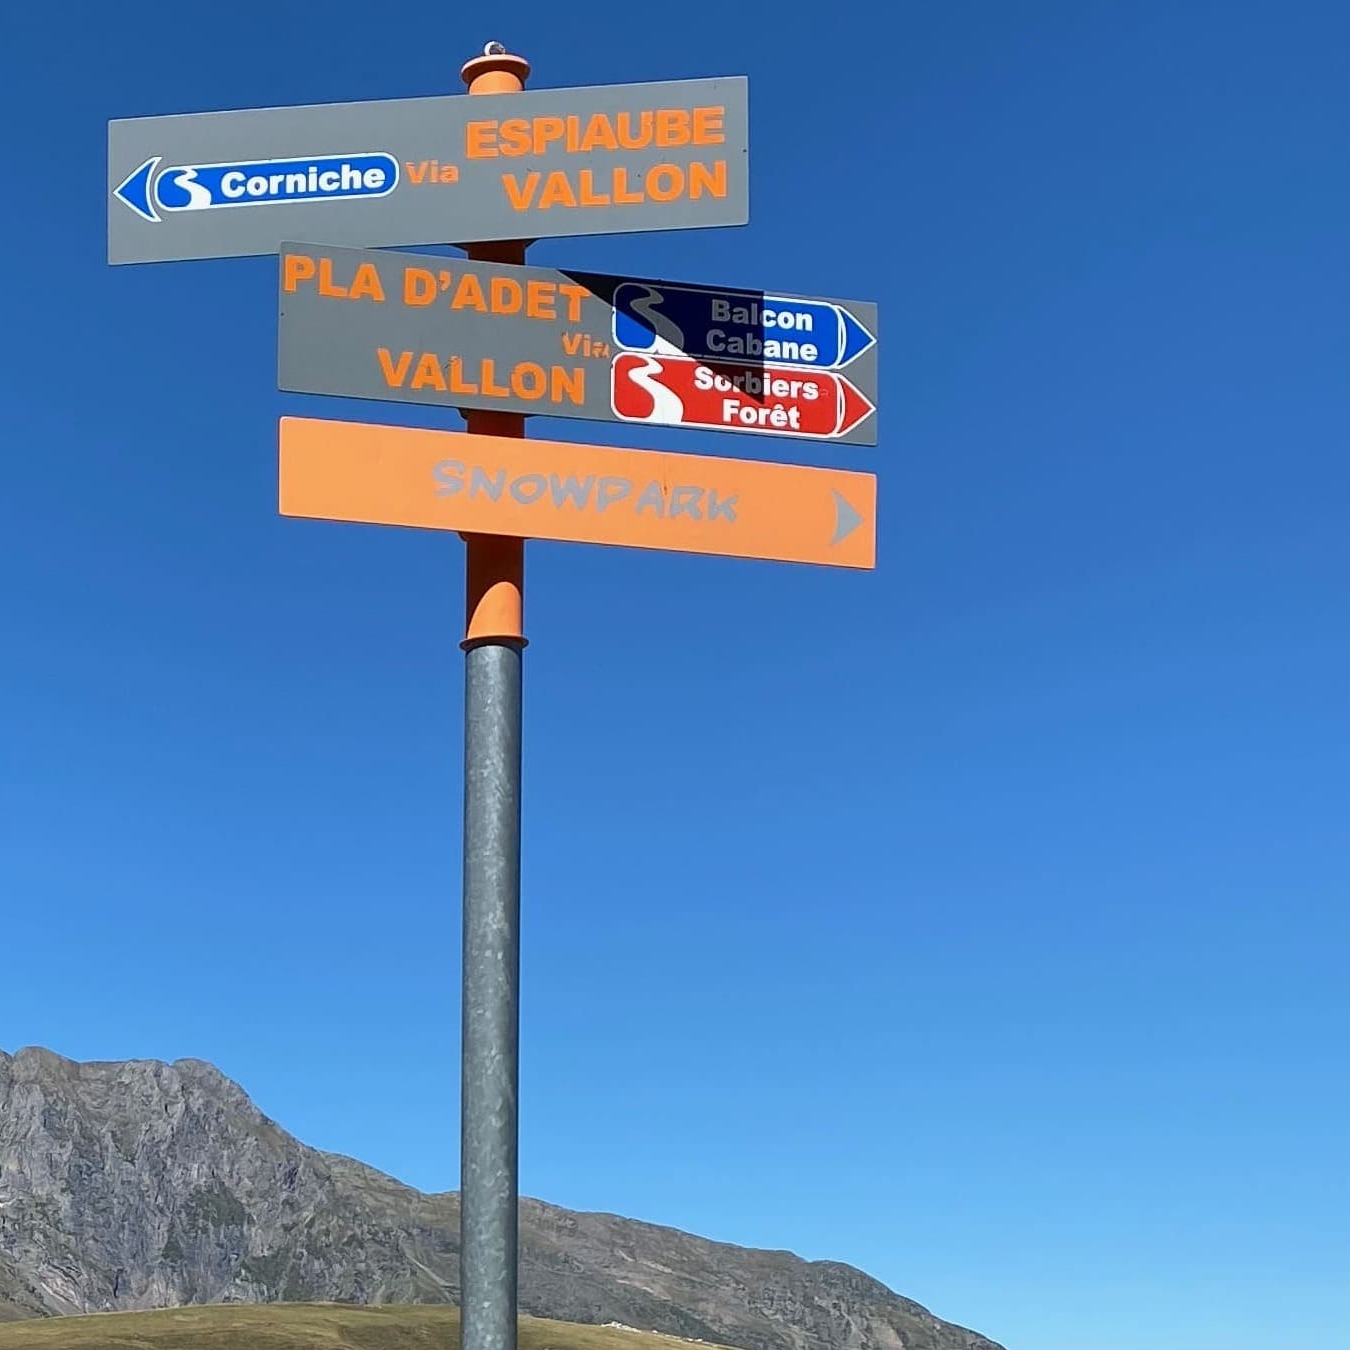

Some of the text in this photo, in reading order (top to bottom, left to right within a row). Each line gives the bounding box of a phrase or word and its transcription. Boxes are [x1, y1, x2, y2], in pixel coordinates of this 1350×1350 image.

[466, 105, 725, 159] ESPIAUBE
[221, 160, 459, 198] Corniche Via
[502, 160, 727, 211] VALLON
[283, 254, 591, 322] PLA D'ADET
[711, 299, 813, 331] Balcon
[561, 332, 610, 358] Via
[706, 329, 818, 362] Cabane
[377, 348, 586, 405] VALLON
[694, 366, 819, 400] Sorbiers
[723, 399, 800, 429] Forêt
[432, 458, 739, 523] SNOWPARK
